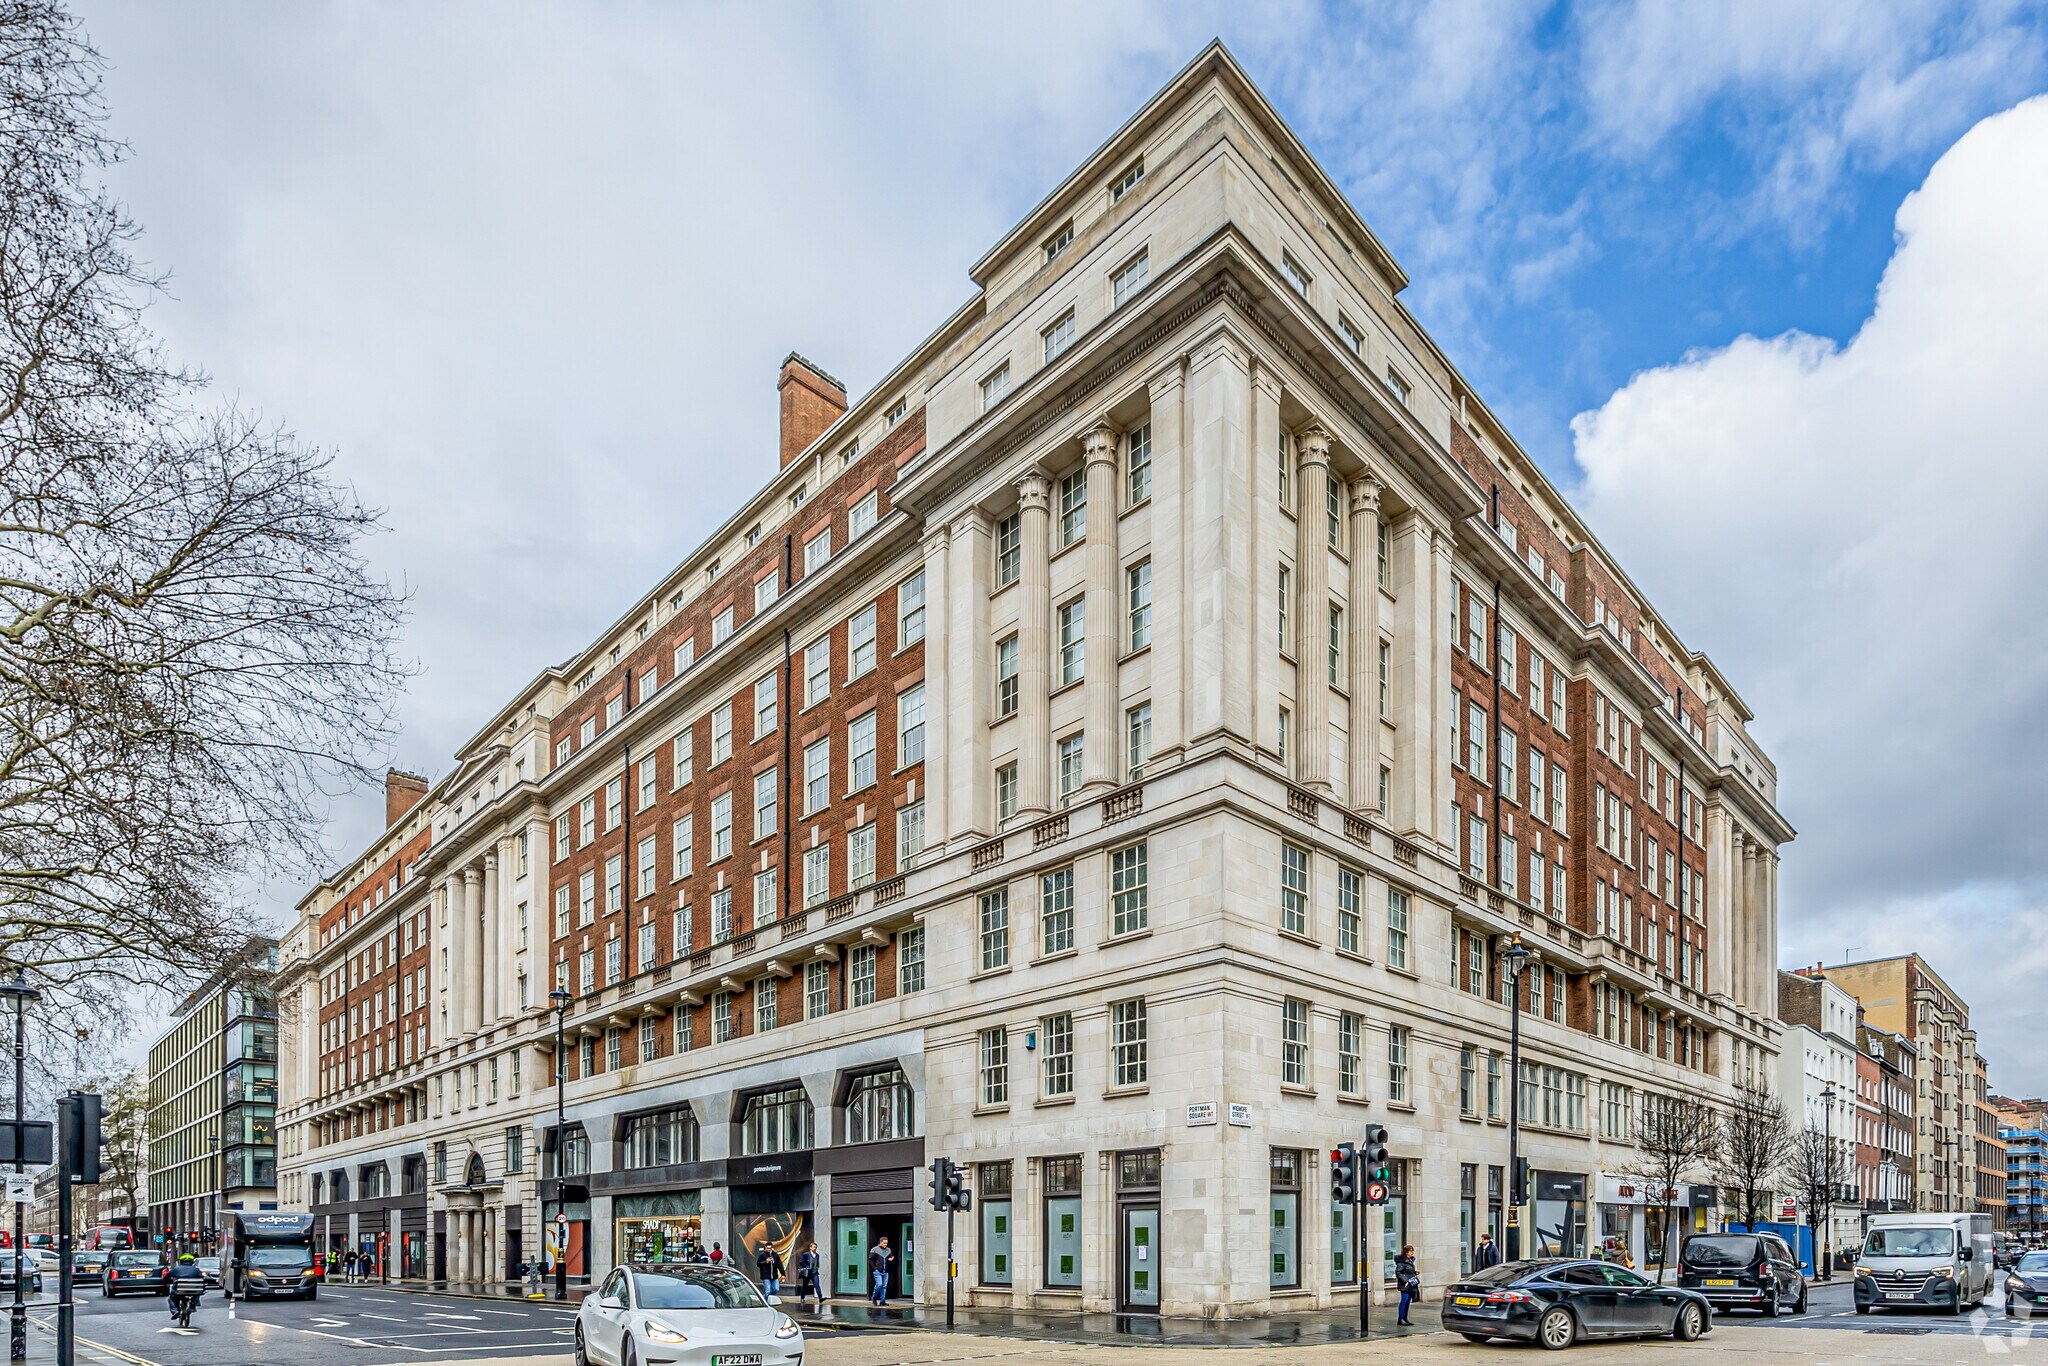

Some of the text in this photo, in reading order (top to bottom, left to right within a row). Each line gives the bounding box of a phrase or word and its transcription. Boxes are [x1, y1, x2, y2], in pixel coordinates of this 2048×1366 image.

[1189, 1105, 1211, 1113] PORTMAN
[257, 1215, 299, 1225] odpod
[718, 1355, 742, 1365] AF22
